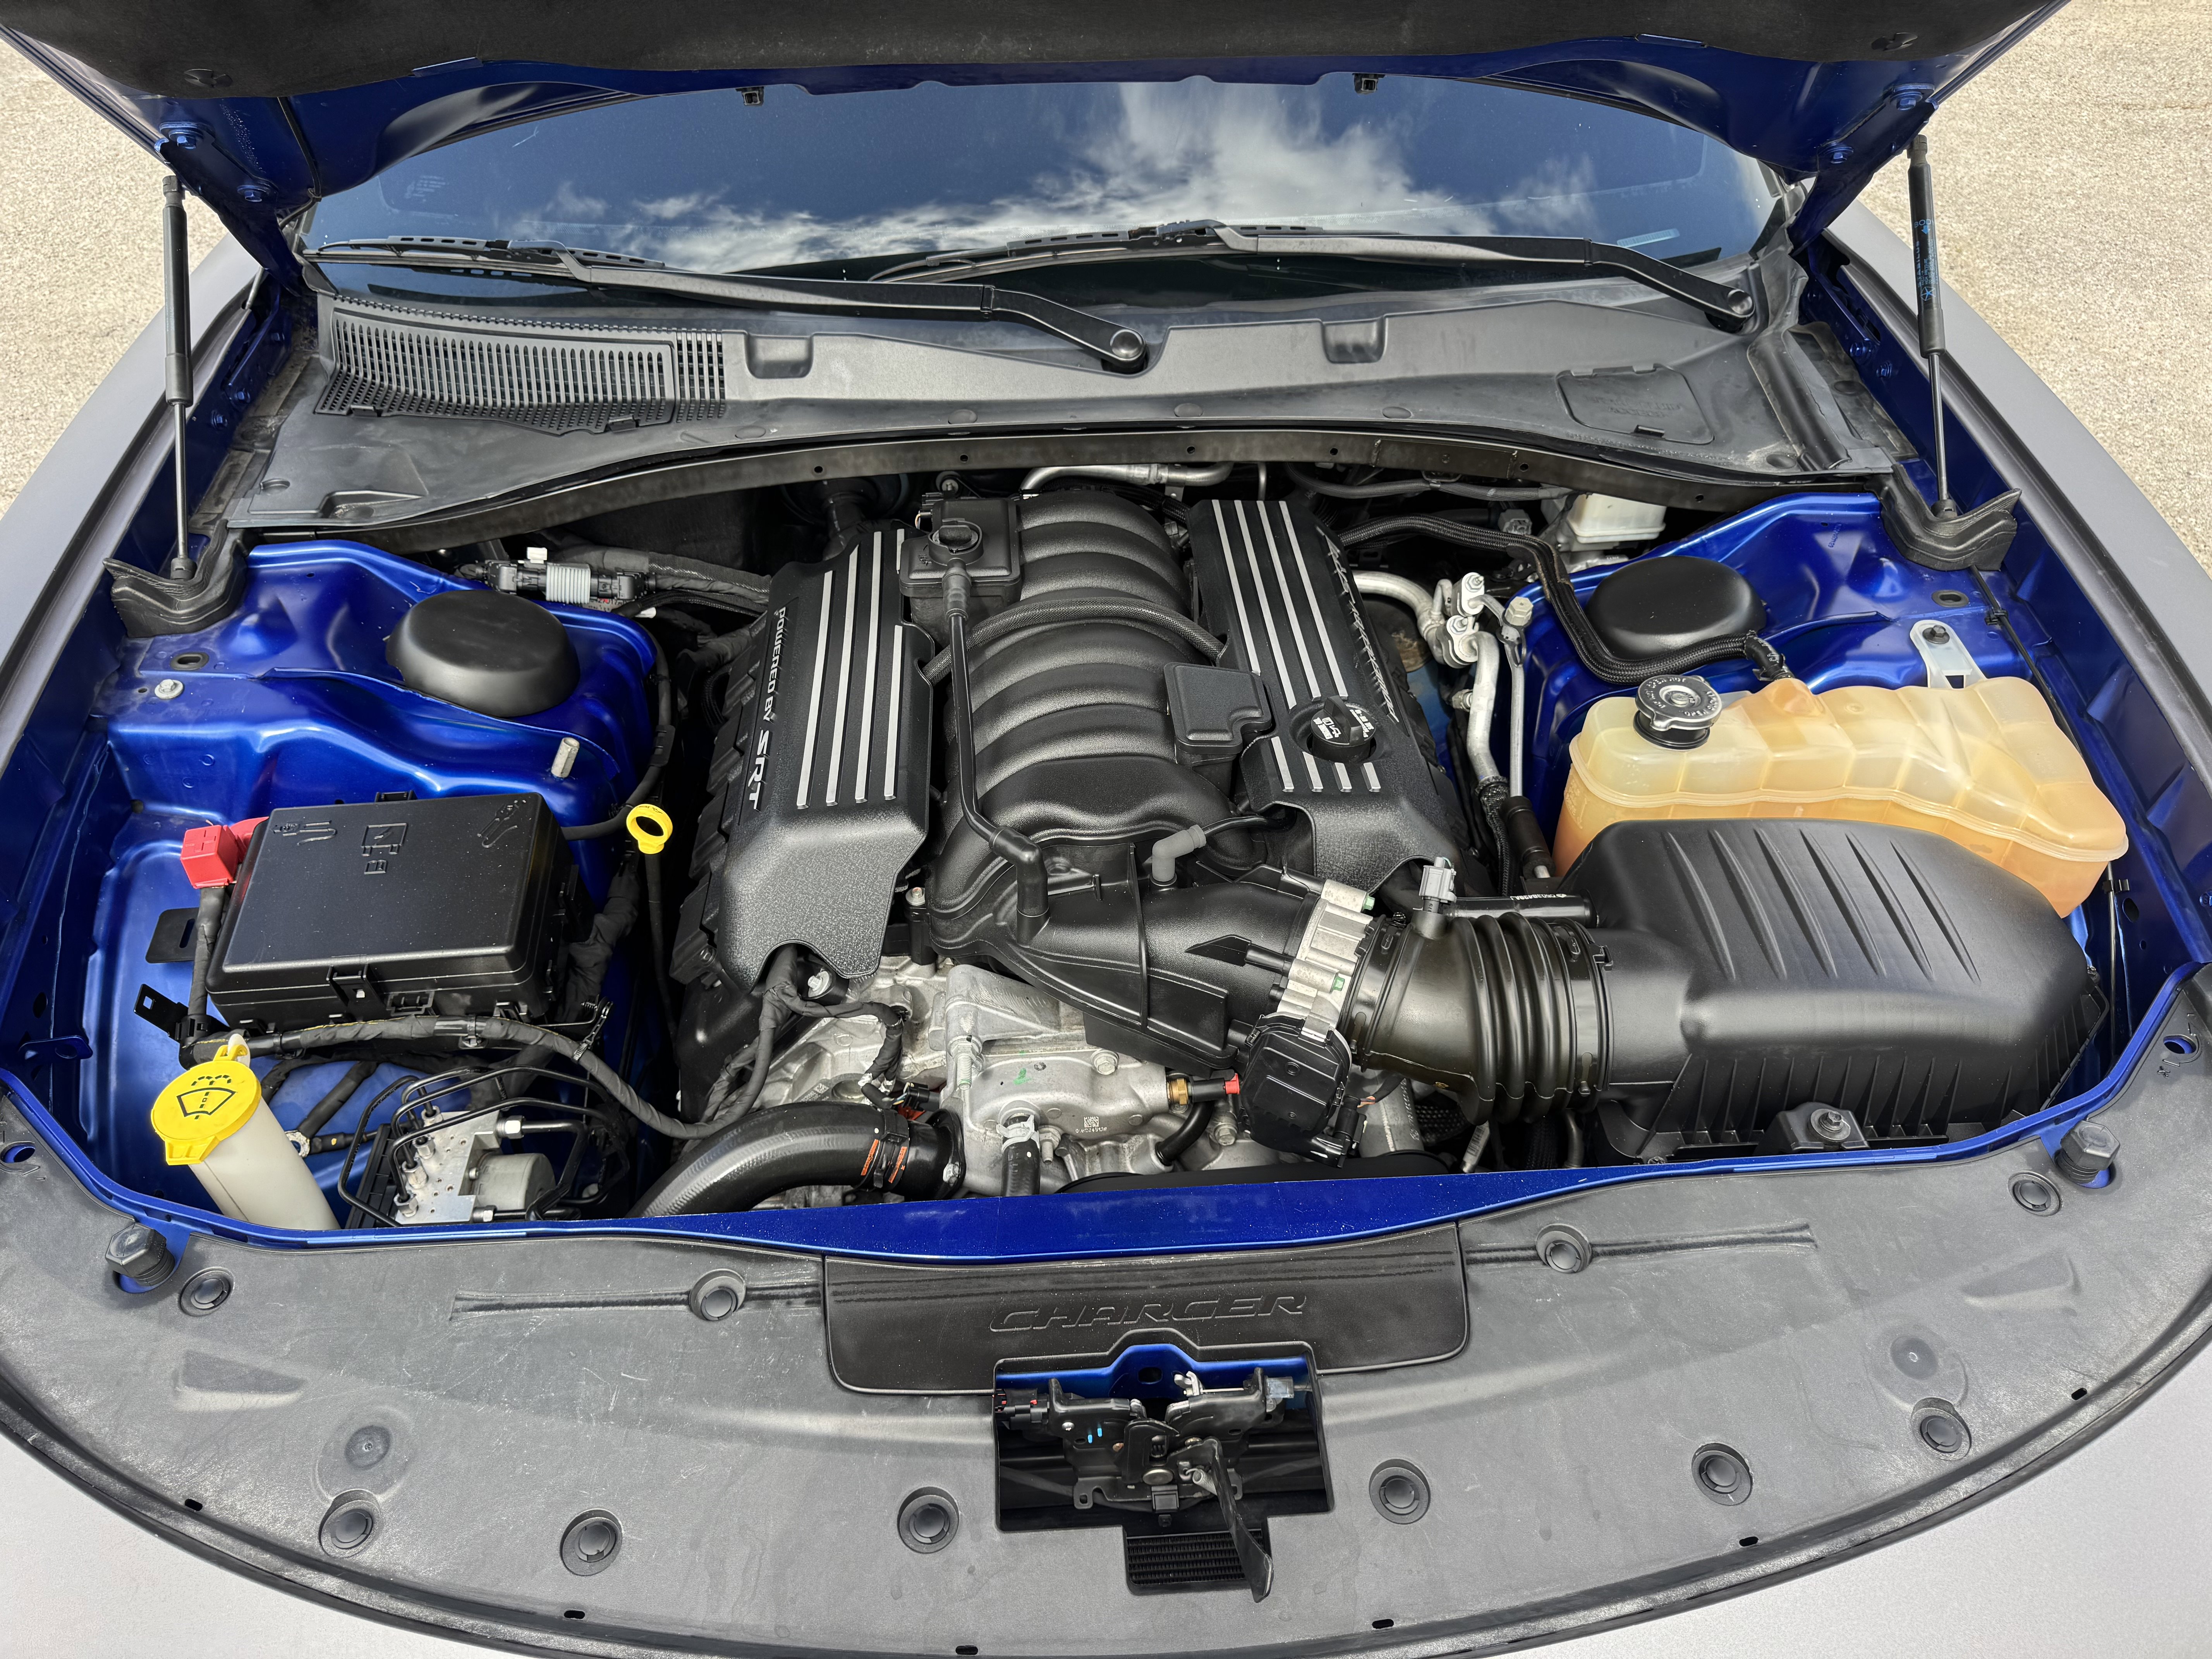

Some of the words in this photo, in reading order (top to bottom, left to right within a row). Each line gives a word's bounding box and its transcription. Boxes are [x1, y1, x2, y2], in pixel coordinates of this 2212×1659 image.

[766, 606, 787, 694] POWERED
[763, 695, 776, 722] BY
[749, 730, 771, 812] SRT
[989, 1293, 1307, 1333] CHARGER
